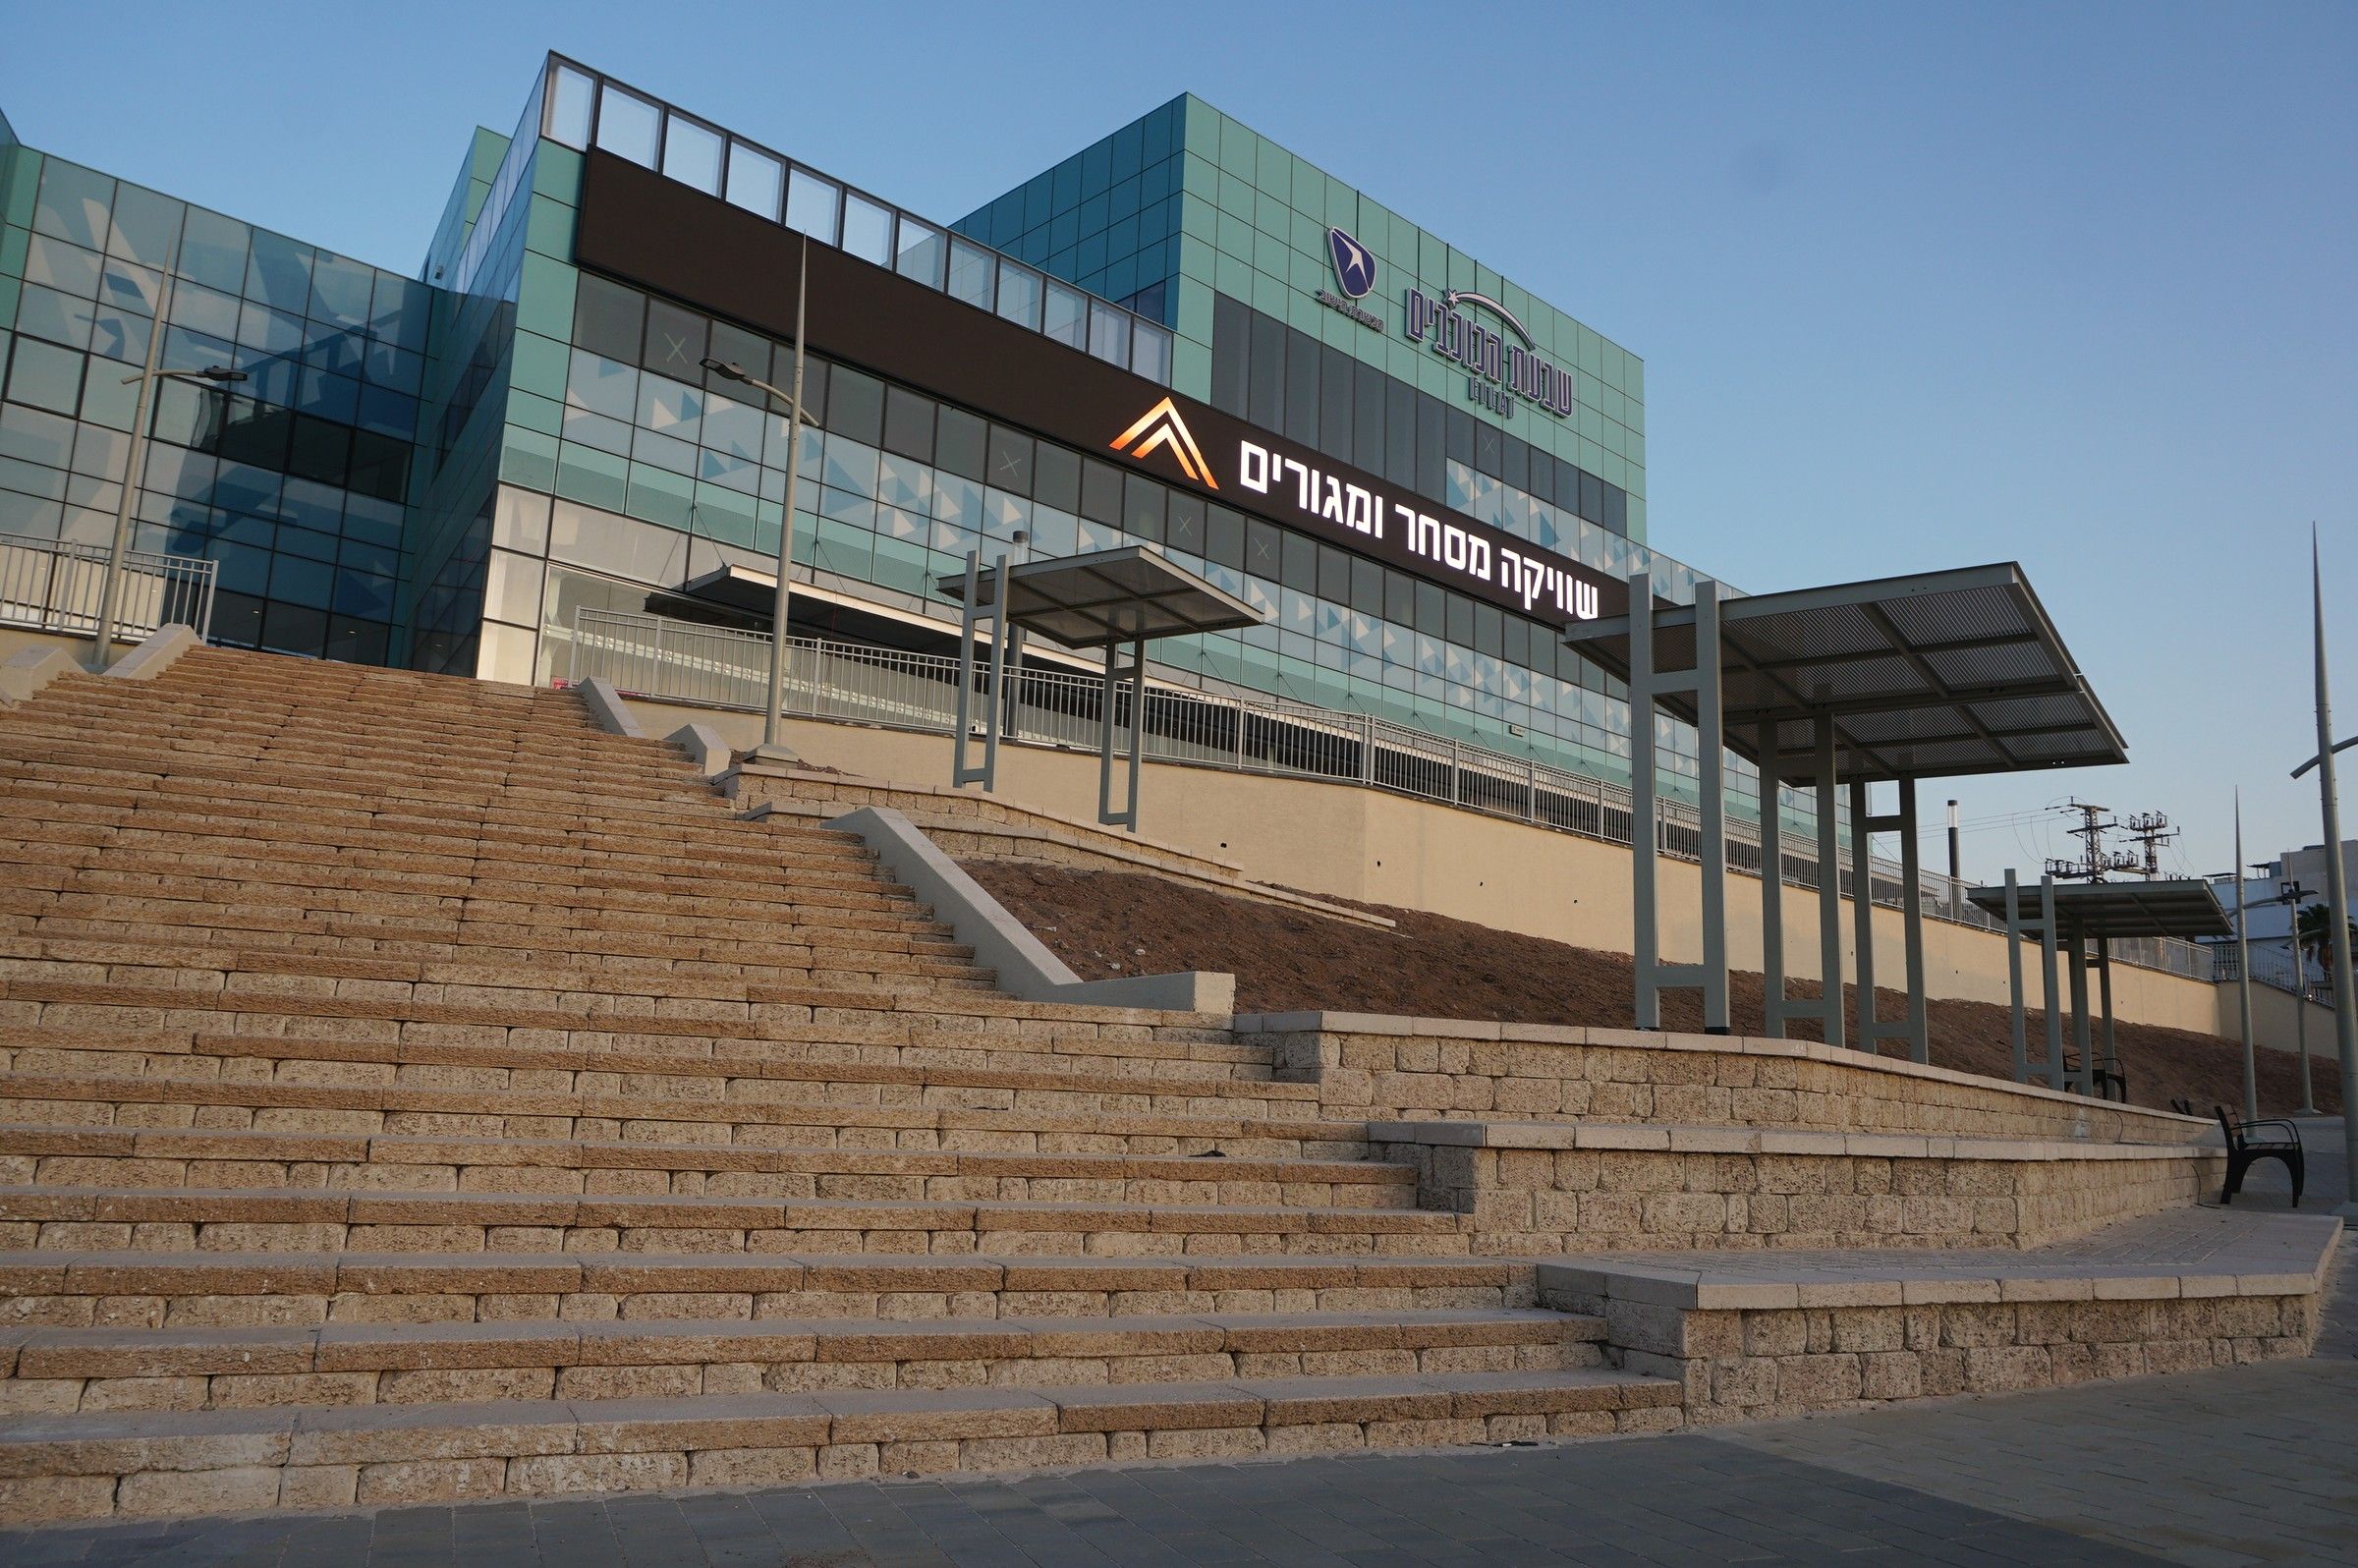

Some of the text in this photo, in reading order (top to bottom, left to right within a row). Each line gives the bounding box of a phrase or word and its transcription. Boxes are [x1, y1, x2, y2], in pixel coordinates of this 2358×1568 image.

[1405, 287, 1572, 418] שבעת הכוכבים
[1469, 376, 1514, 420] EILAT
[1239, 439, 1599, 620] שוויקה מסחר ומגורים
